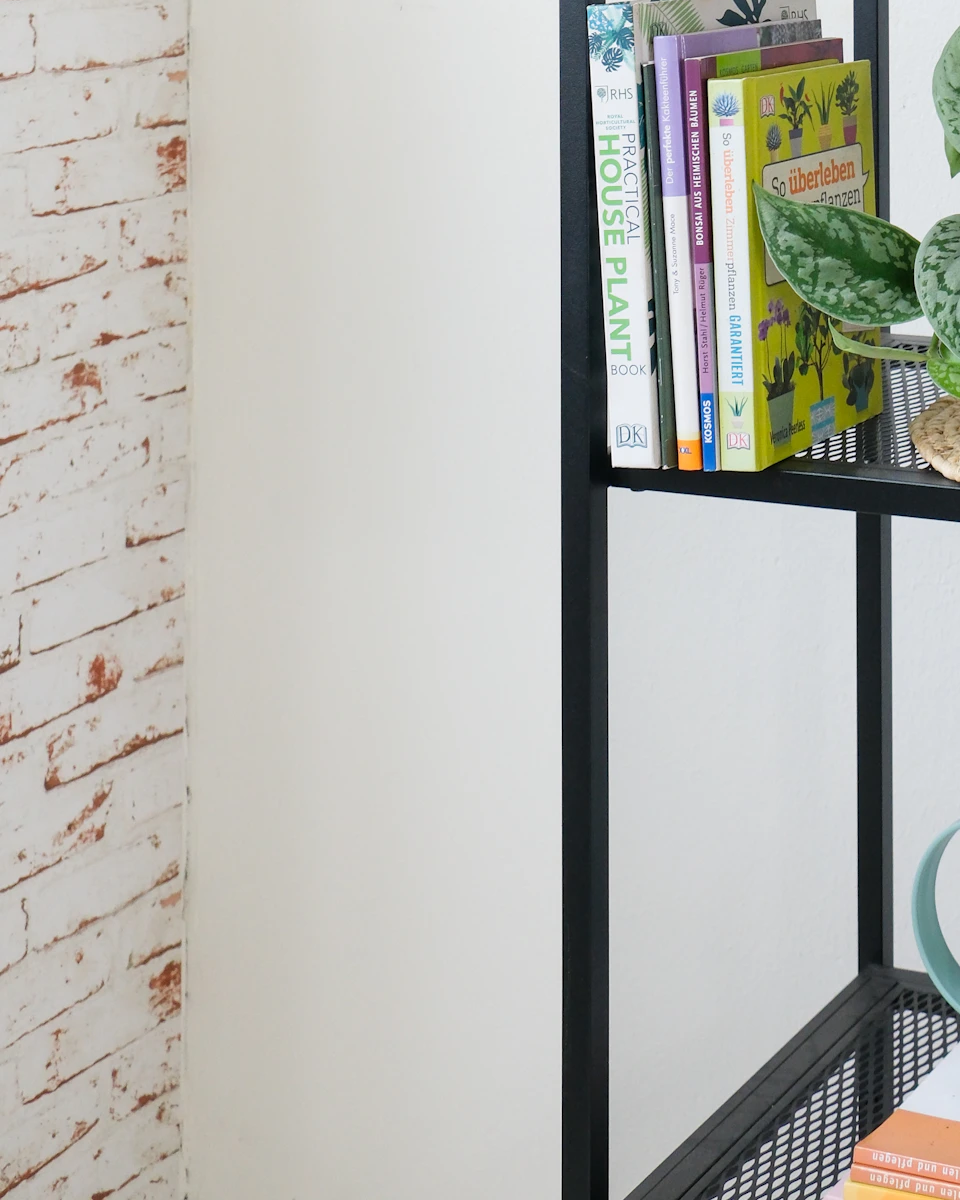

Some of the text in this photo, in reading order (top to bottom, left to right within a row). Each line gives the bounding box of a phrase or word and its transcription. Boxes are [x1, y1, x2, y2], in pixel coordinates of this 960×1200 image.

[610, 88, 634, 100] RHS
[760, 95, 775, 114] DK
[659, 57, 675, 185] Der perfekte Kakteenführer
[689, 90, 704, 245] BONSAI AUS HEIMISCHEN BÄUMEN
[771, 158, 856, 197] So überleben
[622, 133, 640, 245] PRACTICAL
[598, 134, 632, 362] HOUSE PLANT
[722, 132, 744, 386] So überleben Zimmerpflanzen GARANTIERT
[672, 278, 680, 295] Tony
[699, 267, 707, 290] Rüger
[611, 364, 647, 376] BOOK
[702, 400, 713, 443] KOSMOS
[619, 425, 644, 444] DK
[728, 432, 748, 447] DK
[872, 1151, 913, 1171] pflegen
[917, 1159, 938, 1174] und
[869, 1172, 911, 1190] pflegen
[914, 1180, 935, 1195] und
